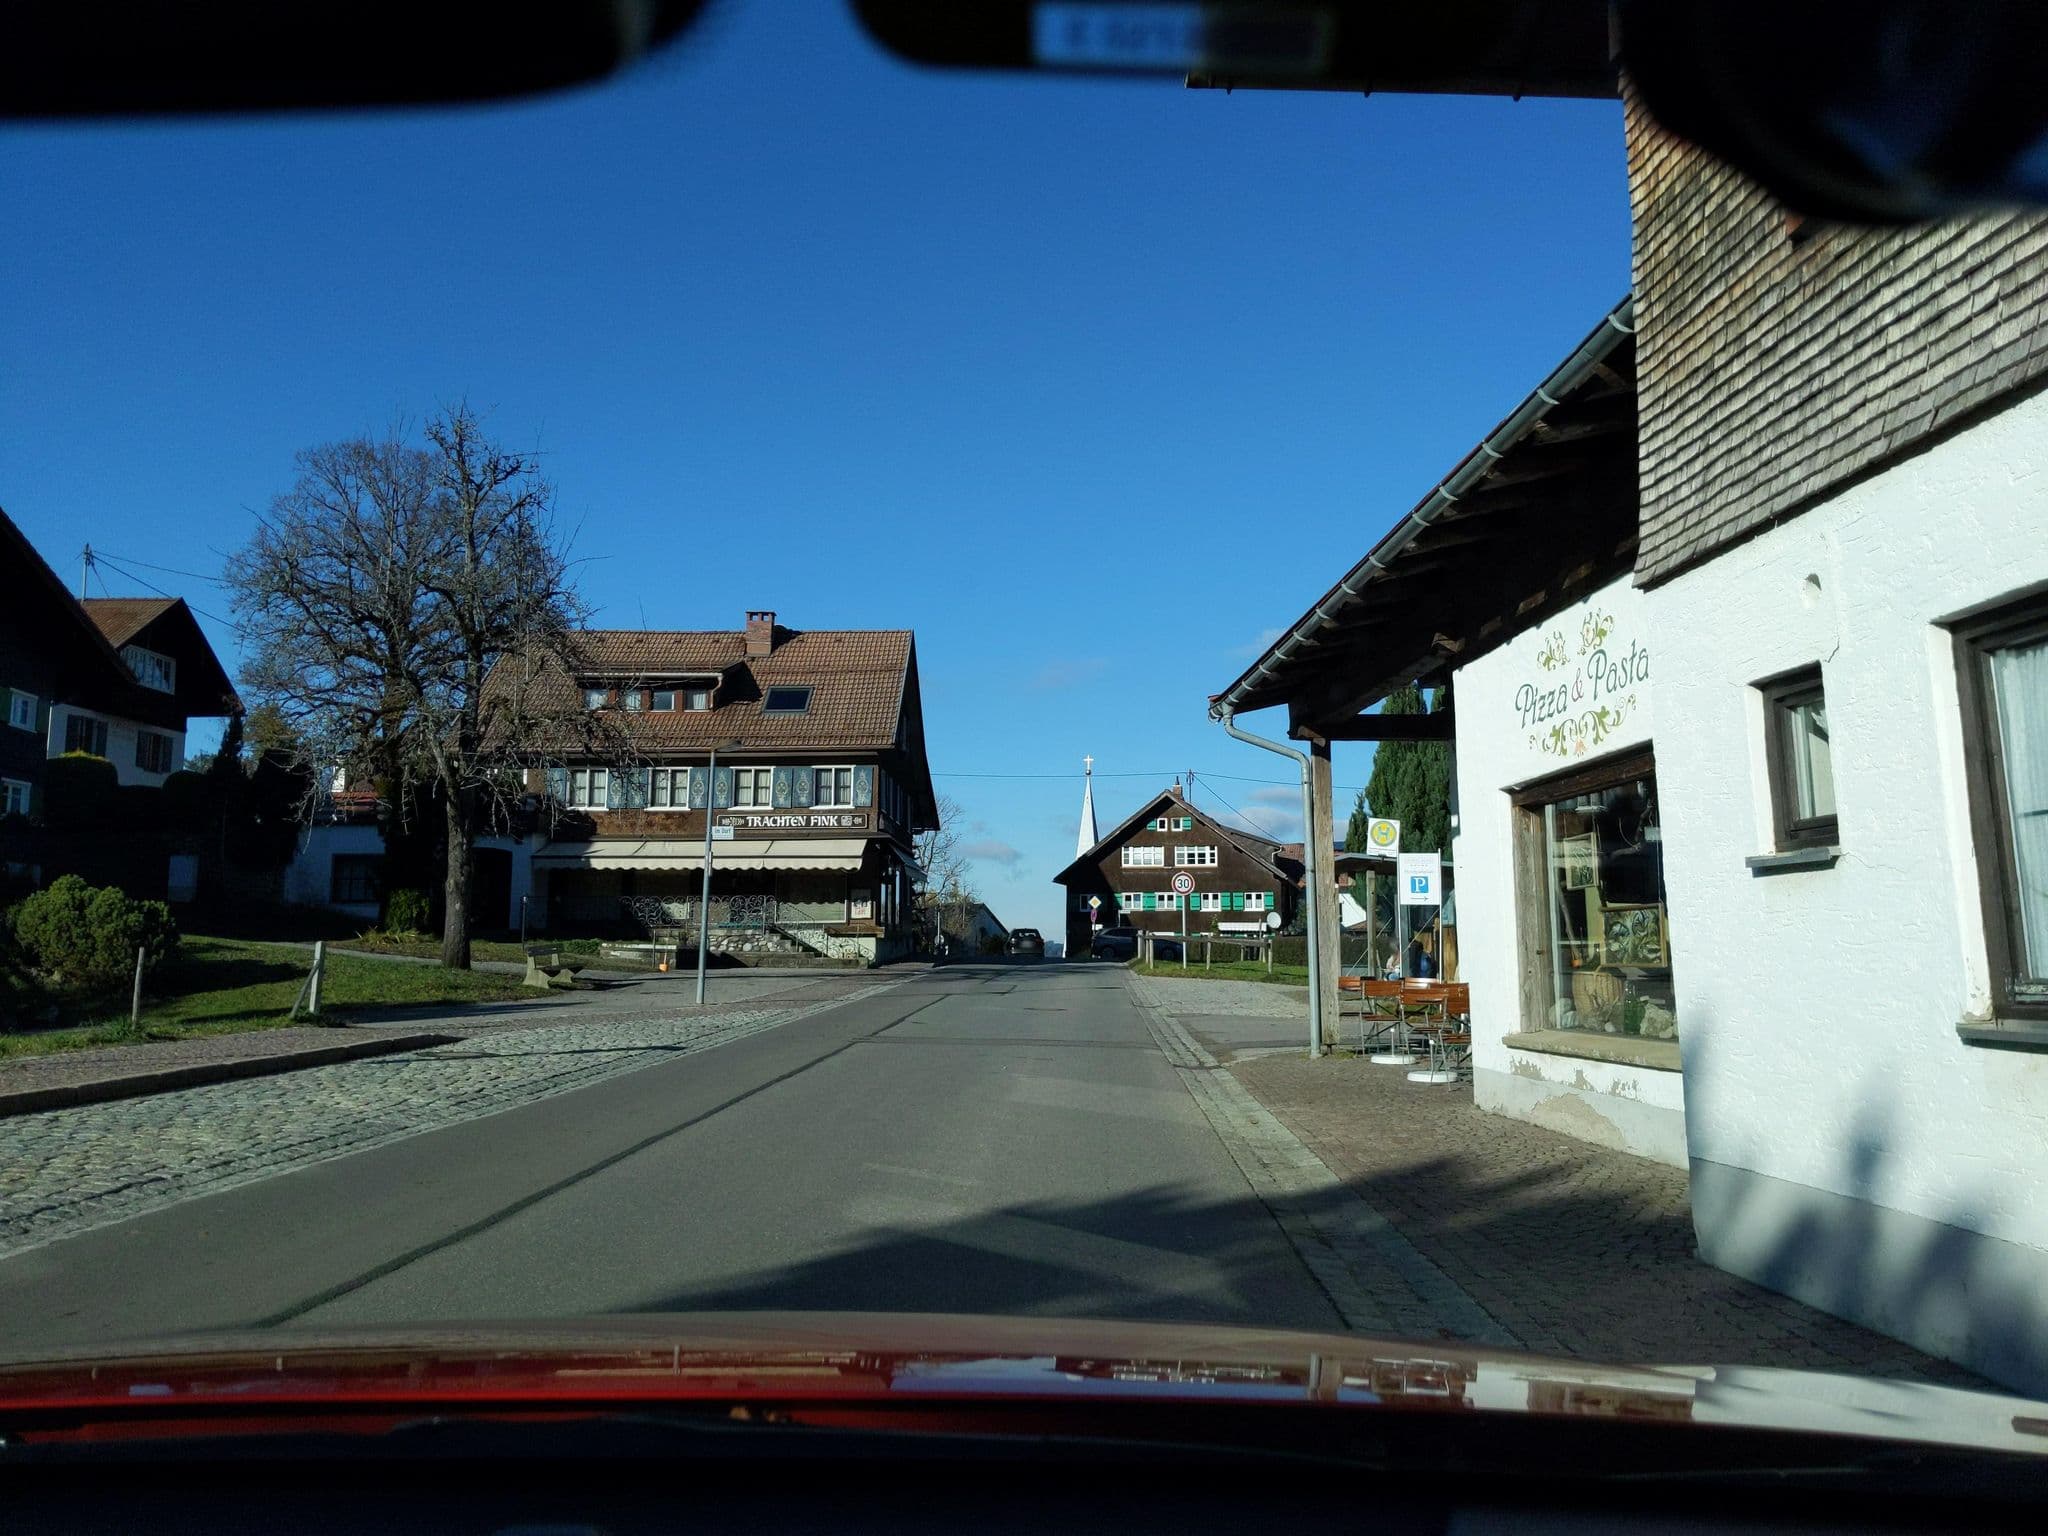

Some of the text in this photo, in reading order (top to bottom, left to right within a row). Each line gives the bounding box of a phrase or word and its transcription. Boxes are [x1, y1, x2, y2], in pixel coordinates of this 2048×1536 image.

[1515, 638, 1649, 729] Pizza & Pasta
[746, 815, 838, 827] TRACHTEN FINK
[1378, 826, 1391, 840] H
[1177, 879, 1190, 889] 30
[1414, 877, 1426, 893] P
